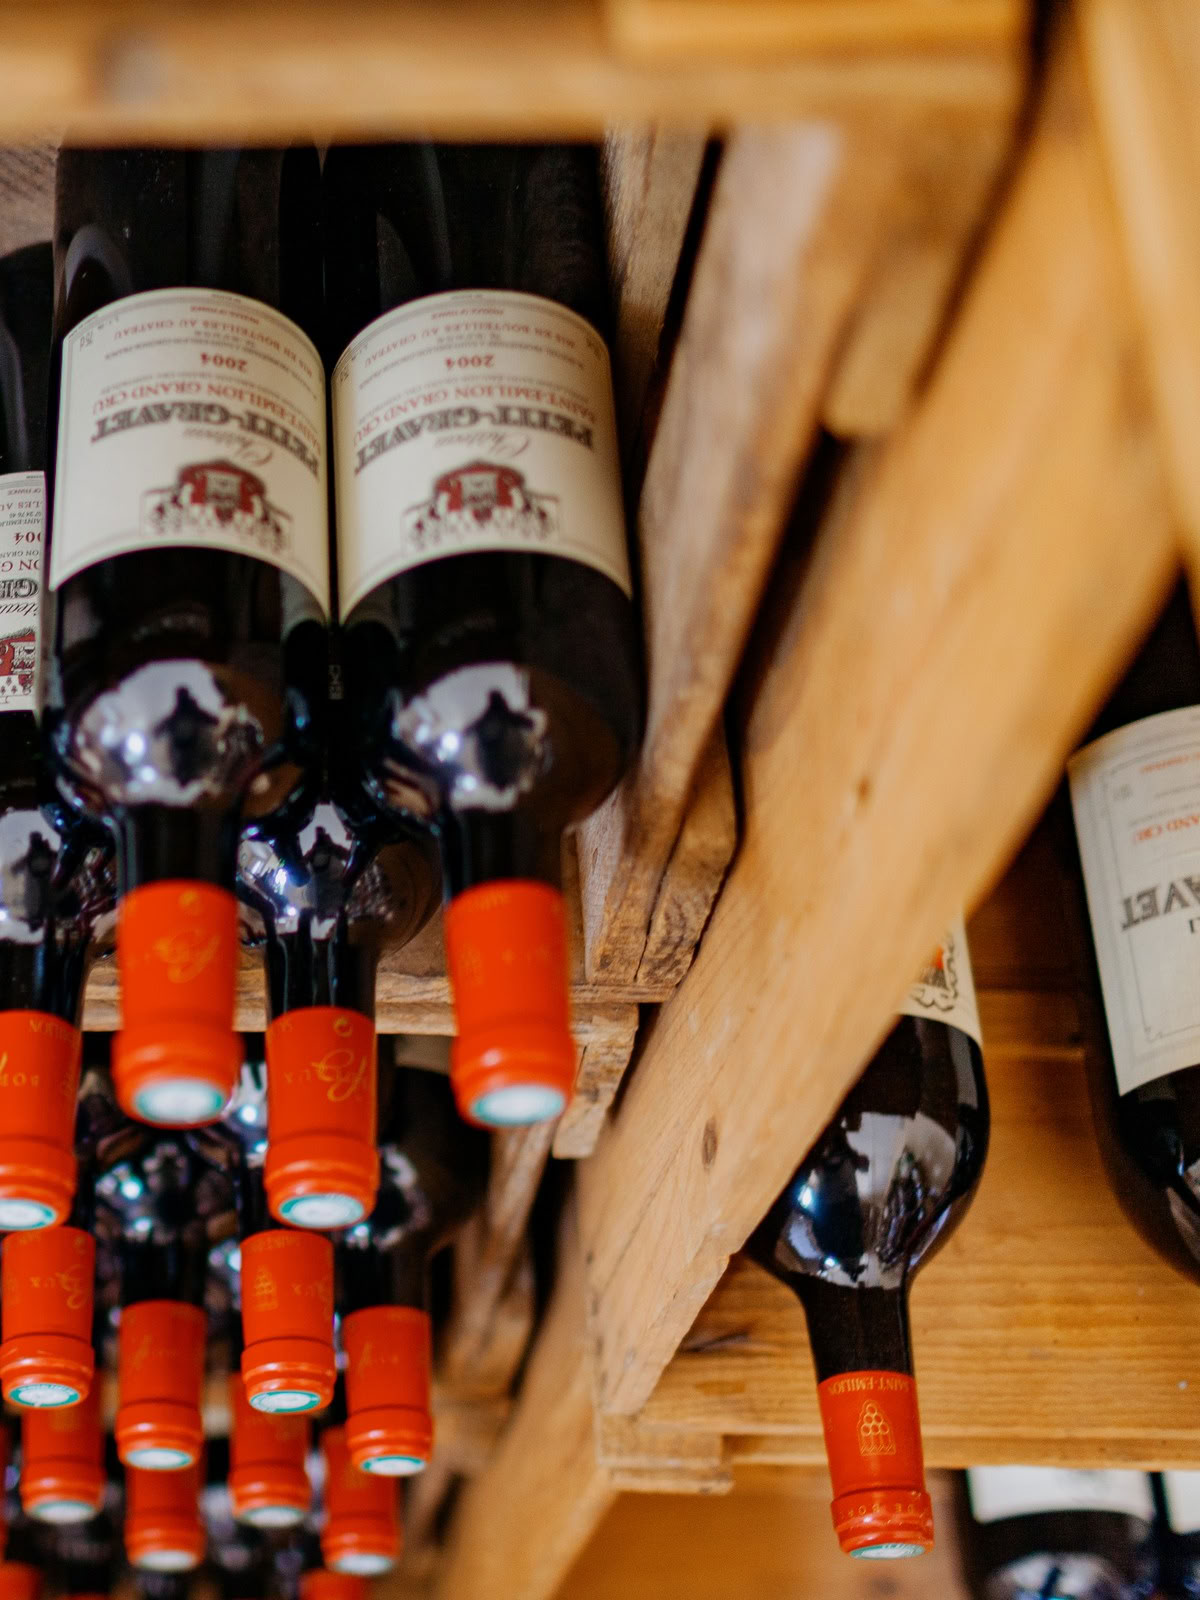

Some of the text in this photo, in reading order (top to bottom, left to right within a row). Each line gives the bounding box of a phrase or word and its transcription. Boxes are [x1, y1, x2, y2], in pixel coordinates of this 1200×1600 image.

[199, 352, 249, 373] 2004
[444, 354, 496, 371] 2004
[93, 390, 127, 417] CRU
[131, 381, 201, 400] GRAND
[382, 389, 449, 419] GRAND
[91, 402, 319, 476] PETIT-GRAVET
[353, 405, 595, 478] PETIT-GRAVET
